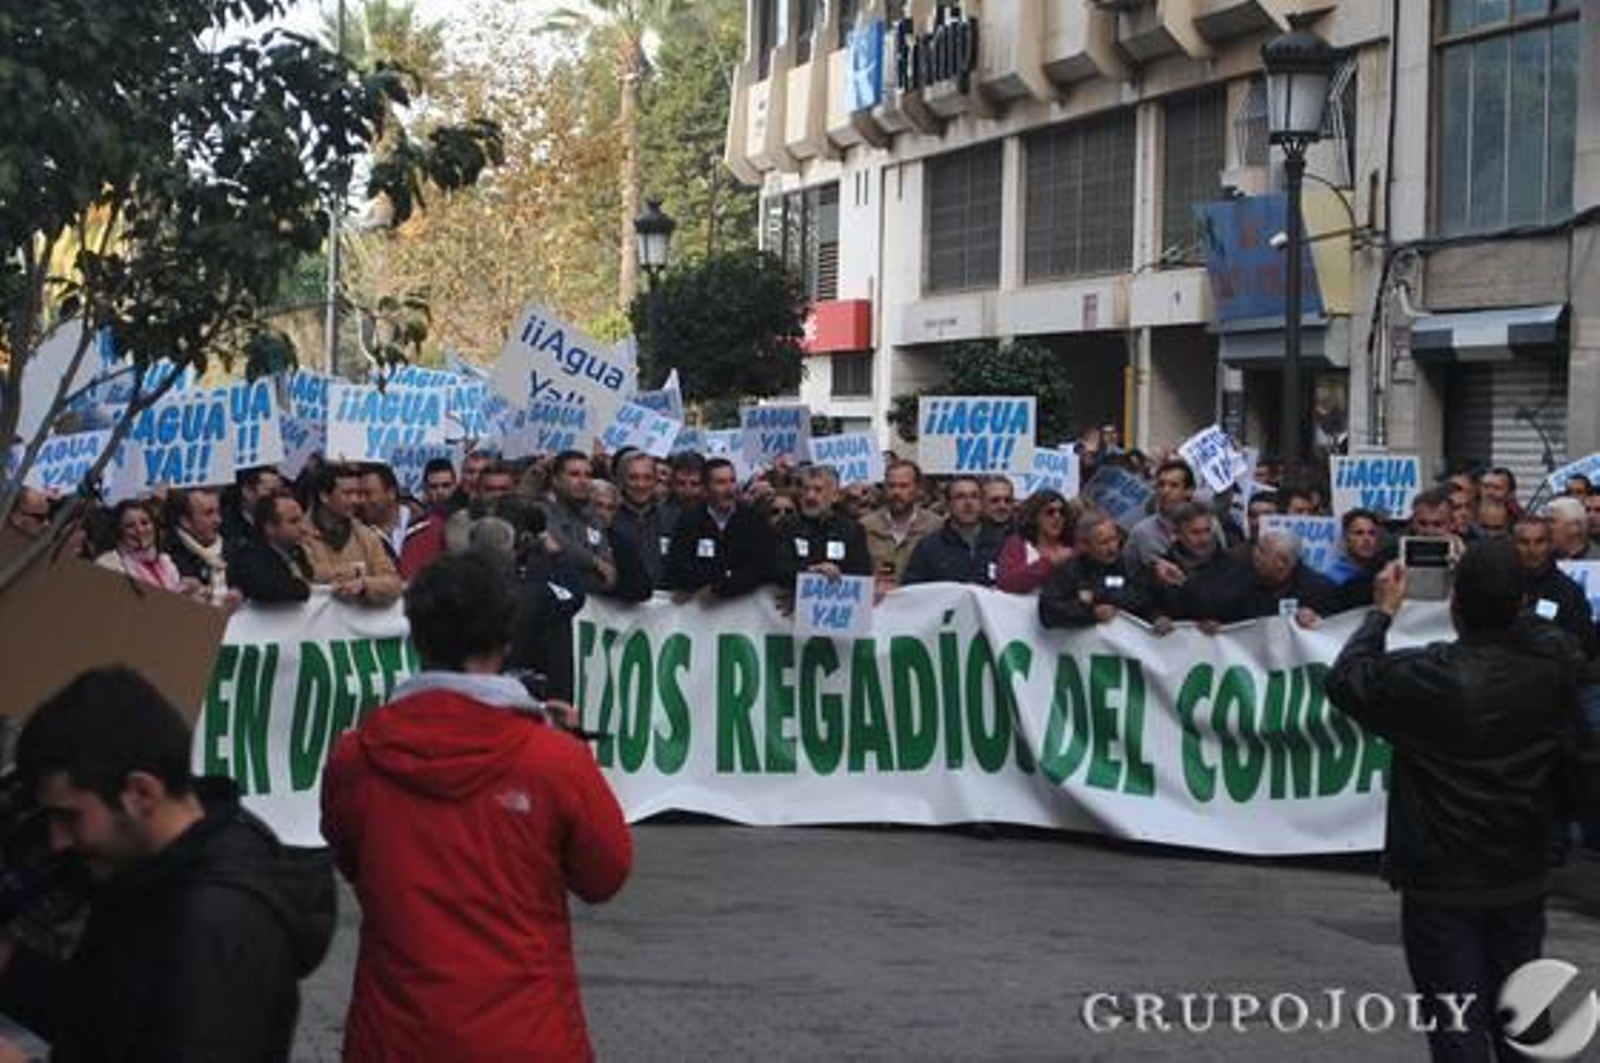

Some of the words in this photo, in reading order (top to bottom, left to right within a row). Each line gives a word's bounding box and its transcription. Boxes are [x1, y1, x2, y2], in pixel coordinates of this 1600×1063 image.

[924, 401, 1030, 435] ¡¡AGUA
[144, 443, 212, 486] YA!!
[955, 436, 1017, 471] YA!!
[1336, 459, 1418, 489] ¡¡AGUA
[204, 644, 277, 795] EN
[1038, 653, 1156, 797] DEL
